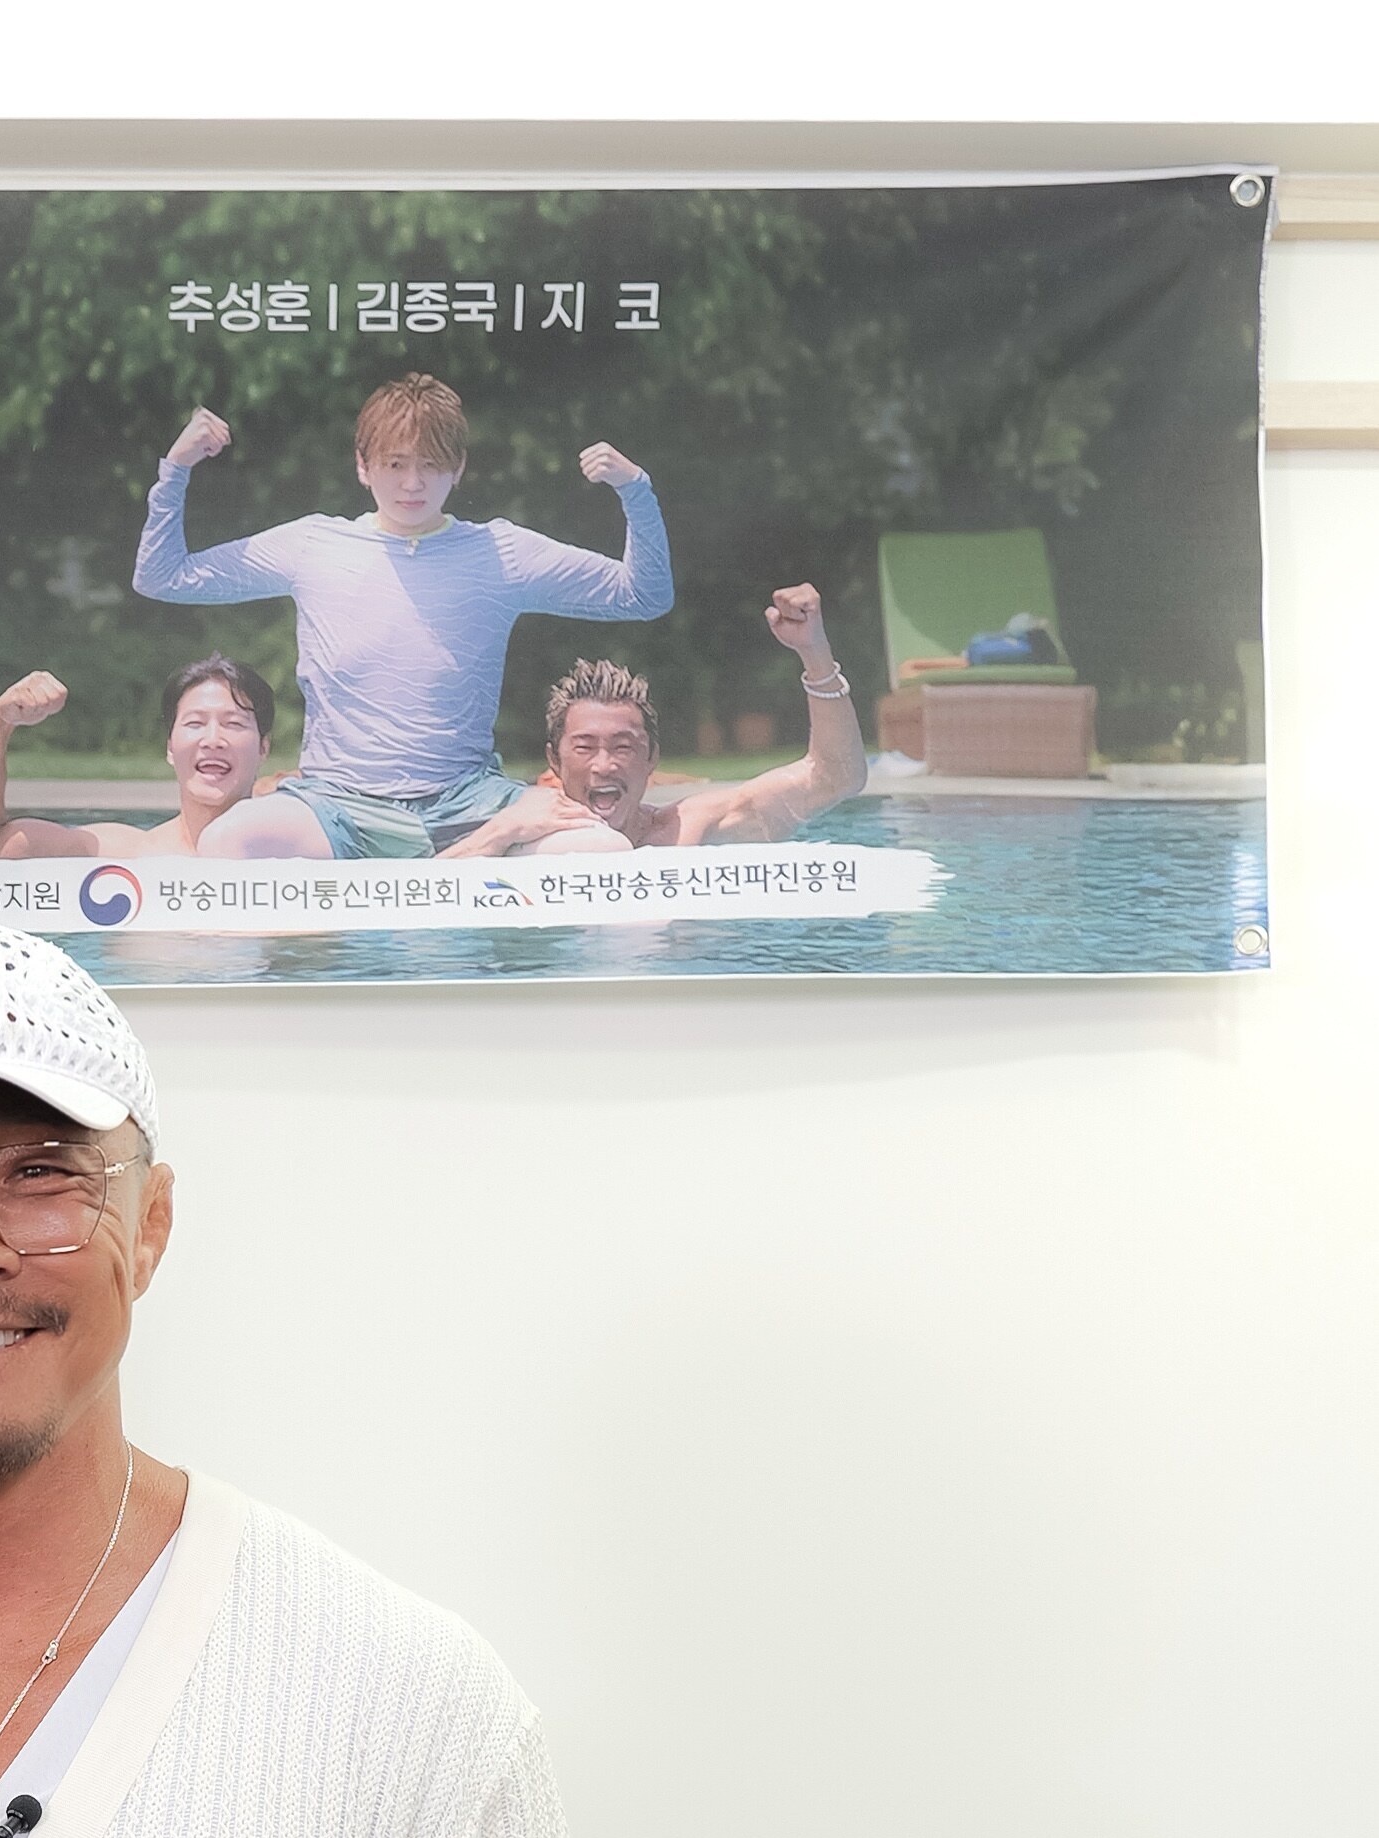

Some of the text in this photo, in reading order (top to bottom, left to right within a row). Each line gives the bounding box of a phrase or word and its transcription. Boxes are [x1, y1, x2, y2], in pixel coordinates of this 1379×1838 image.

[167, 279, 312, 333] 추성훈
[356, 281, 498, 333] 김종국
[158, 877, 461, 912] 방송미디어통신위원회
[473, 894, 520, 908] KCA
[540, 859, 857, 905] 한국방송통신전파진흥원
